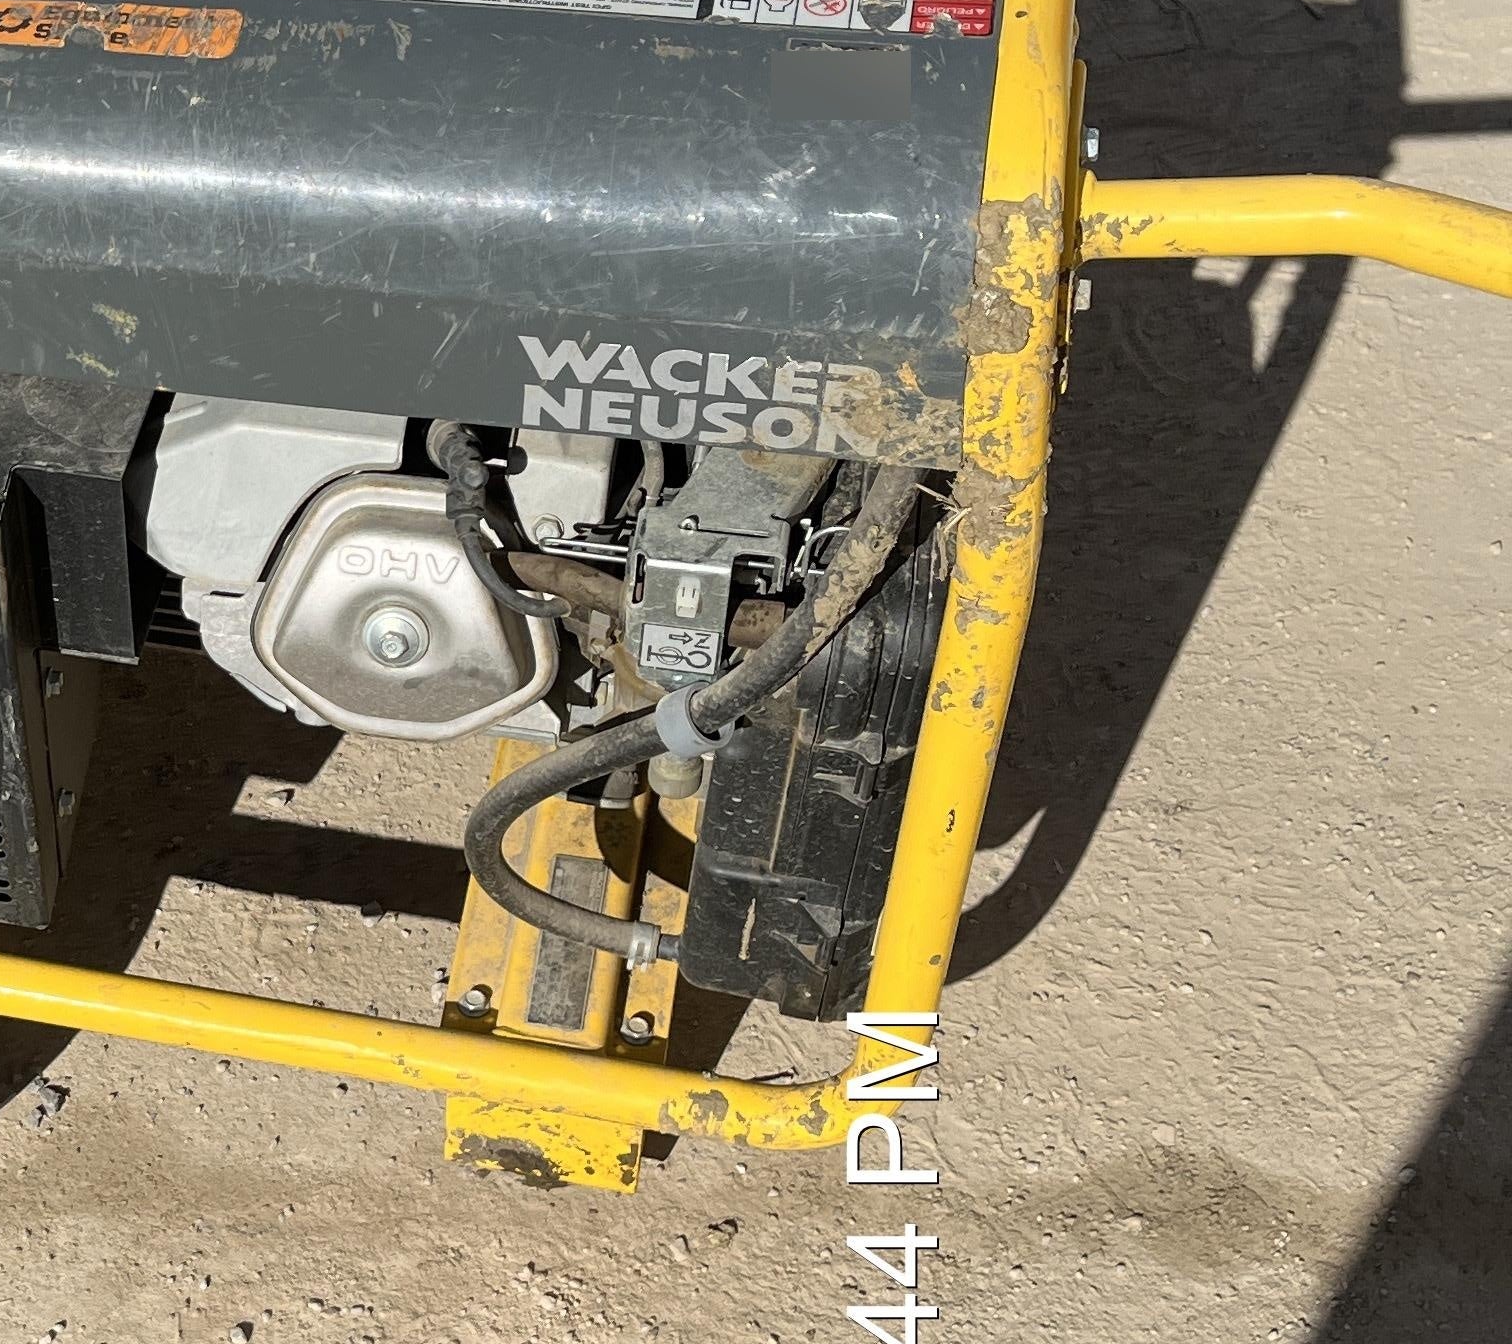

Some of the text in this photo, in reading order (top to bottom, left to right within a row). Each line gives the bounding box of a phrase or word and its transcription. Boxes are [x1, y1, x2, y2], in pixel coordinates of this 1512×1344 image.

[917, 5, 974, 16] PELIGRO
[517, 333, 881, 406] WACKER
[519, 385, 881, 457] NEUSON
[337, 544, 460, 584] OHV
